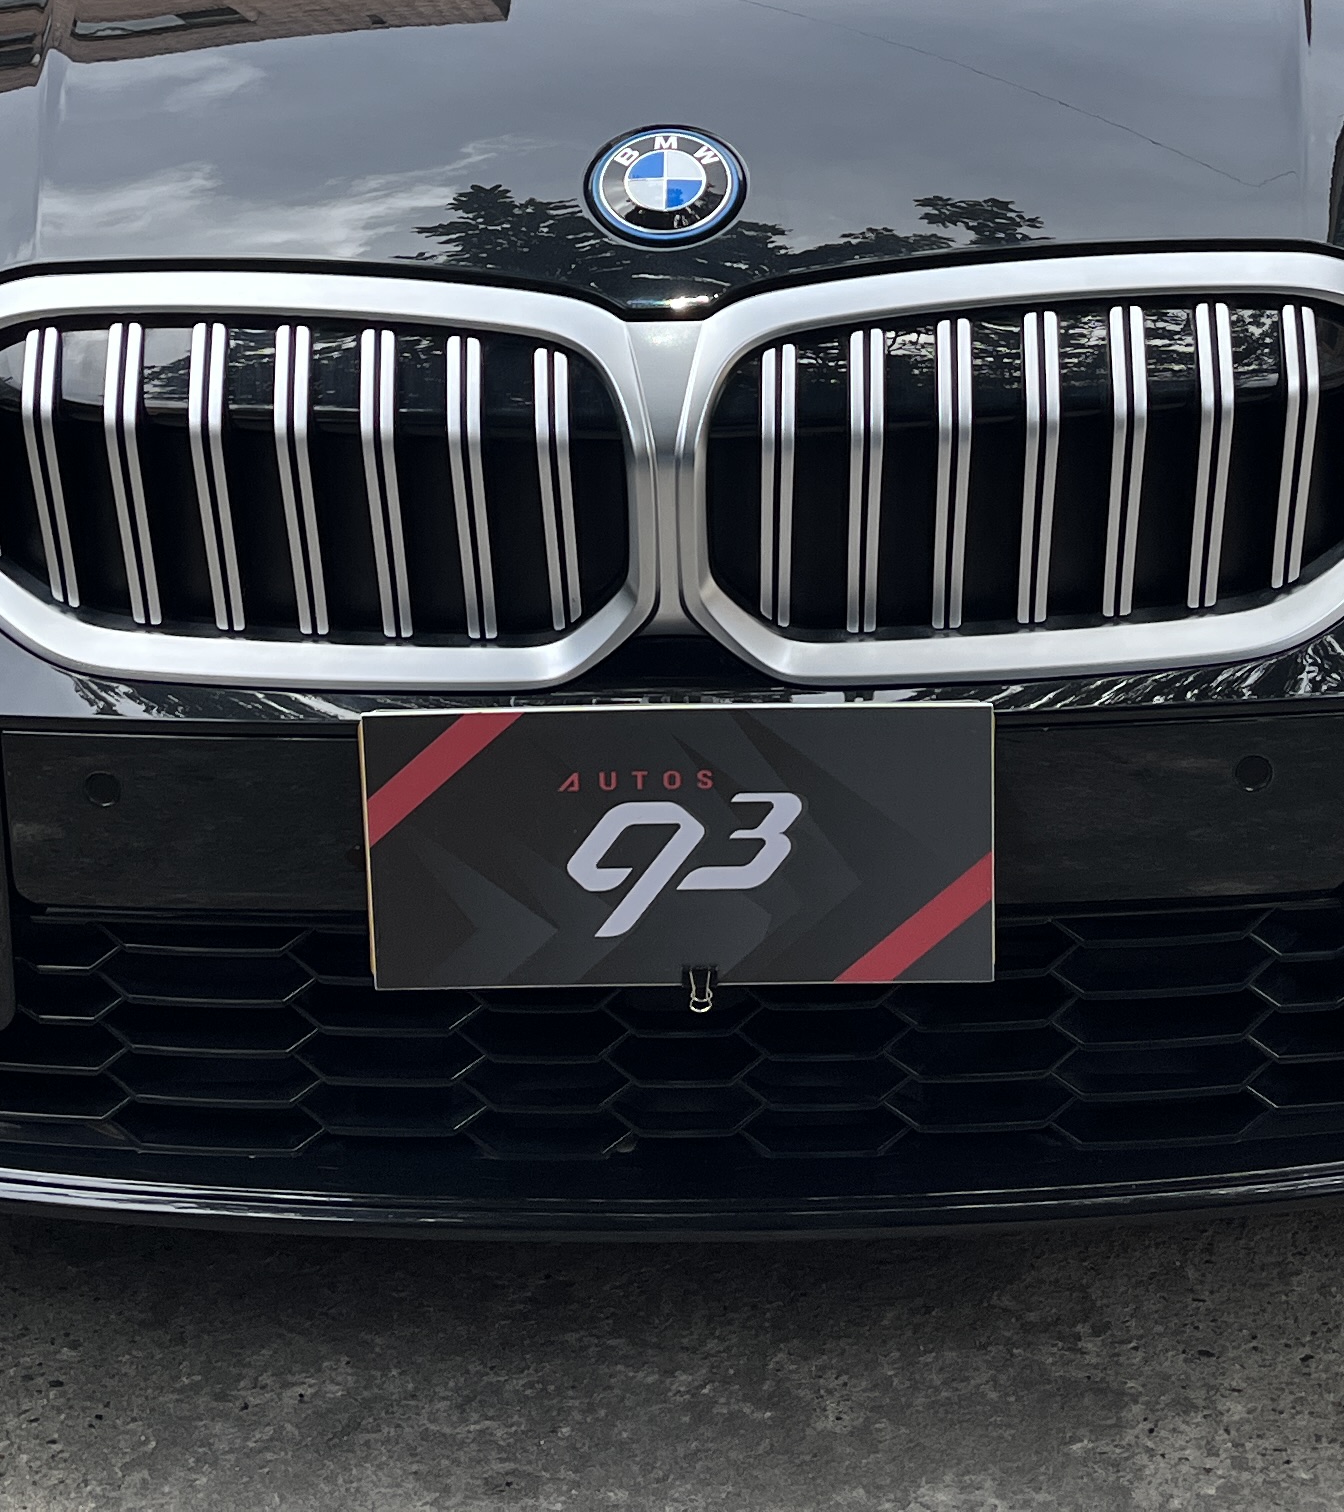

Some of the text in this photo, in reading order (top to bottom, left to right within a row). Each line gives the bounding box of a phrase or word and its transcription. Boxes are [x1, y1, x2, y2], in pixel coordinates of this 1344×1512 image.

[613, 135, 721, 167] BMW
[557, 769, 716, 793] AUTOS
[566, 791, 804, 938] 93
